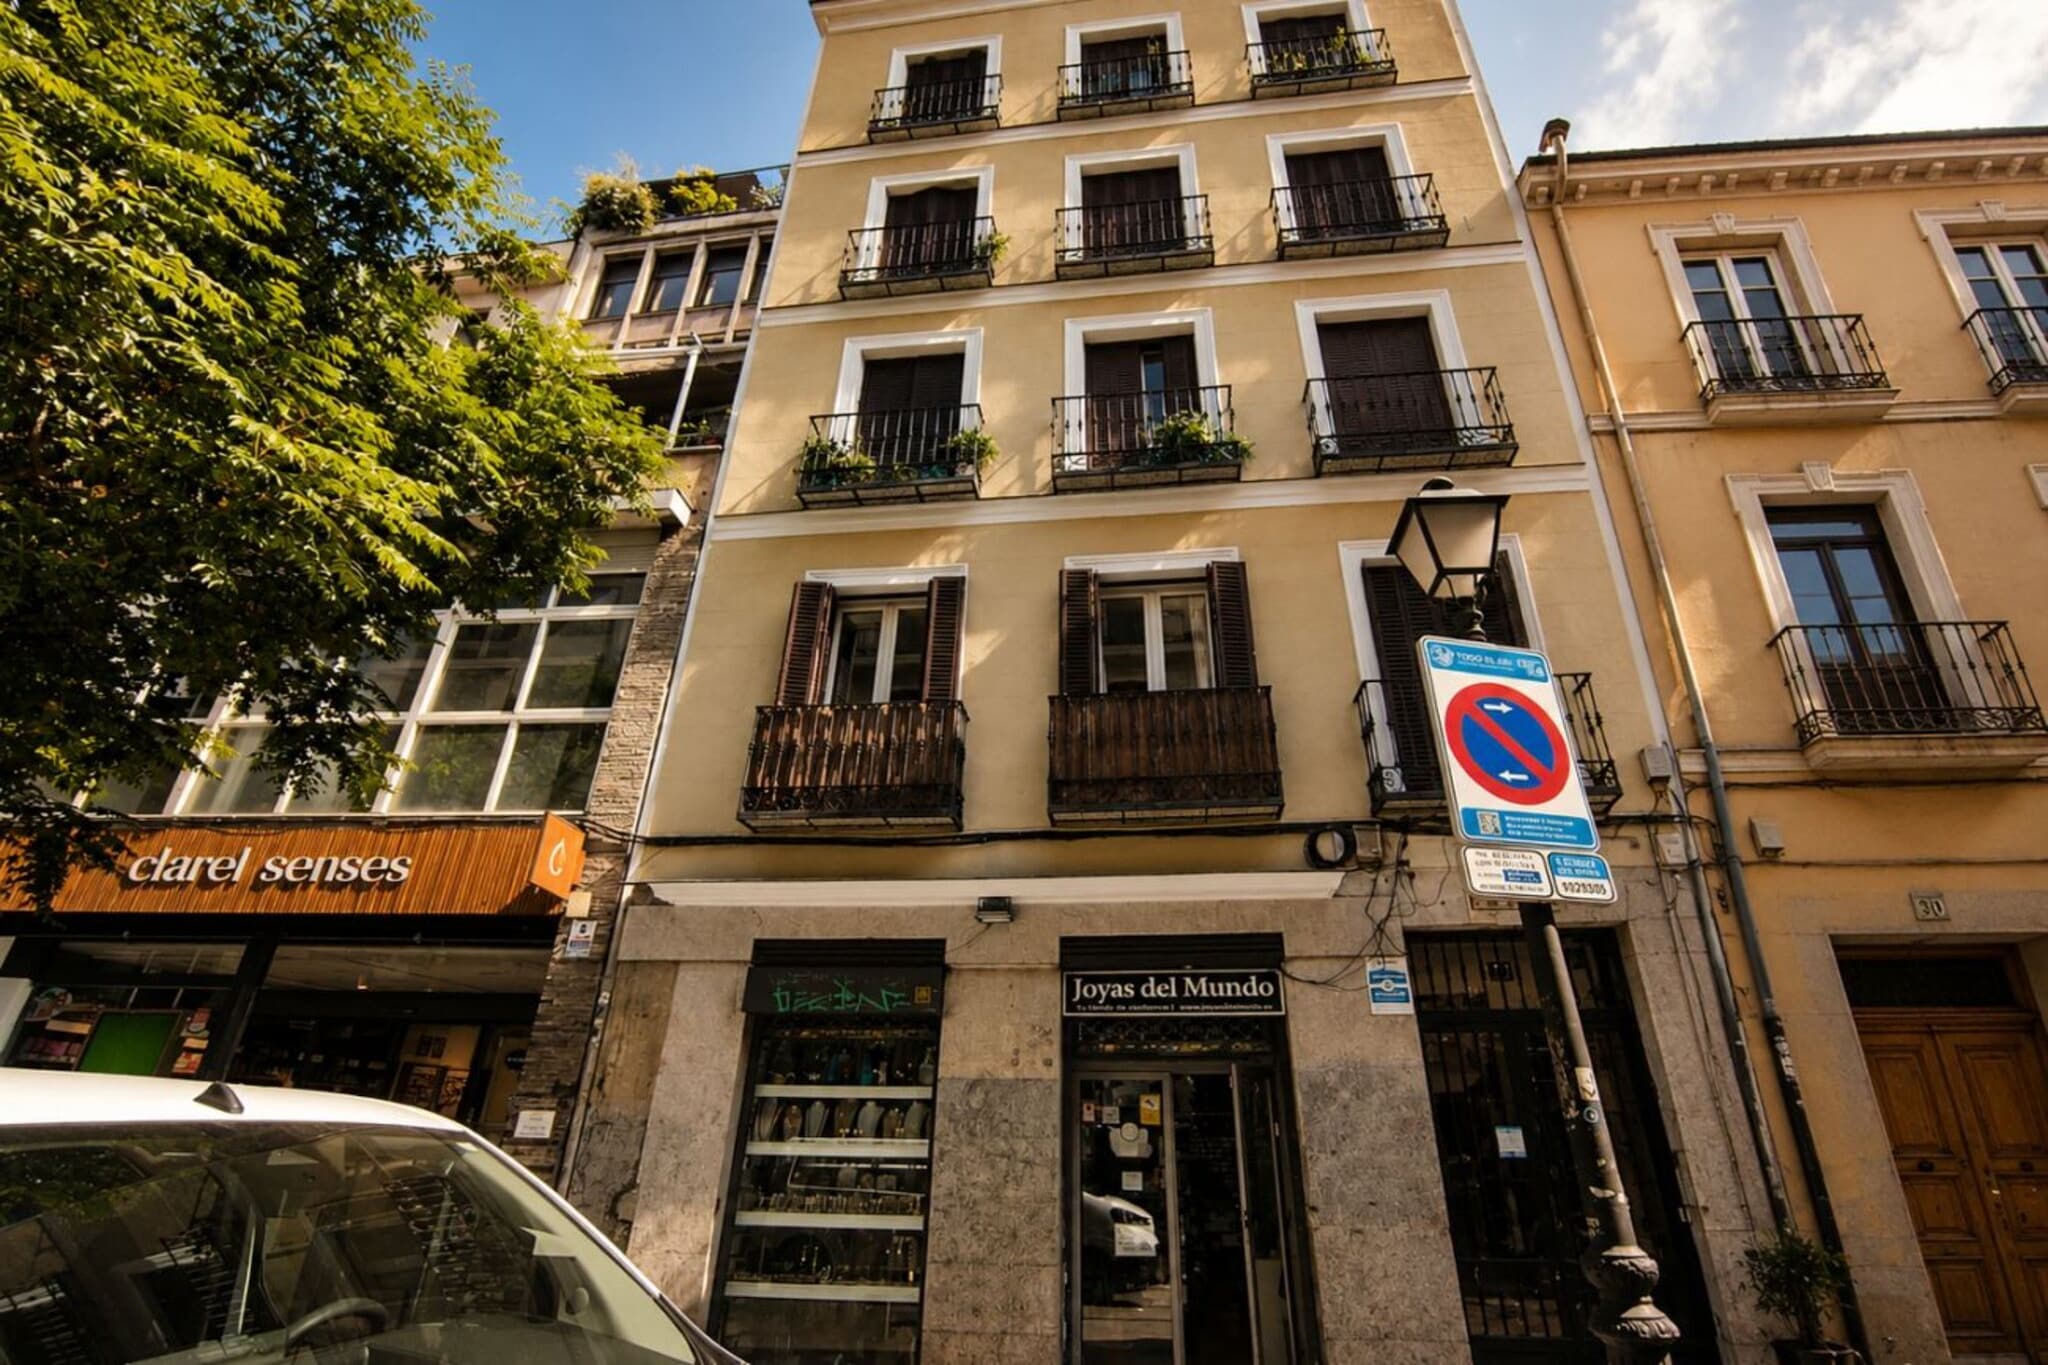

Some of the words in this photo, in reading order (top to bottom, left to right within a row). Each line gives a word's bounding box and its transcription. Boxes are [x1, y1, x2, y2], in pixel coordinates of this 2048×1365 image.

[128, 846, 252, 883] clarel
[259, 855, 412, 883] senses
[1918, 899, 1945, 918] 30
[1072, 977, 1136, 1004] Joyas
[1140, 976, 1177, 998] del
[1183, 975, 1274, 998] Mundo
